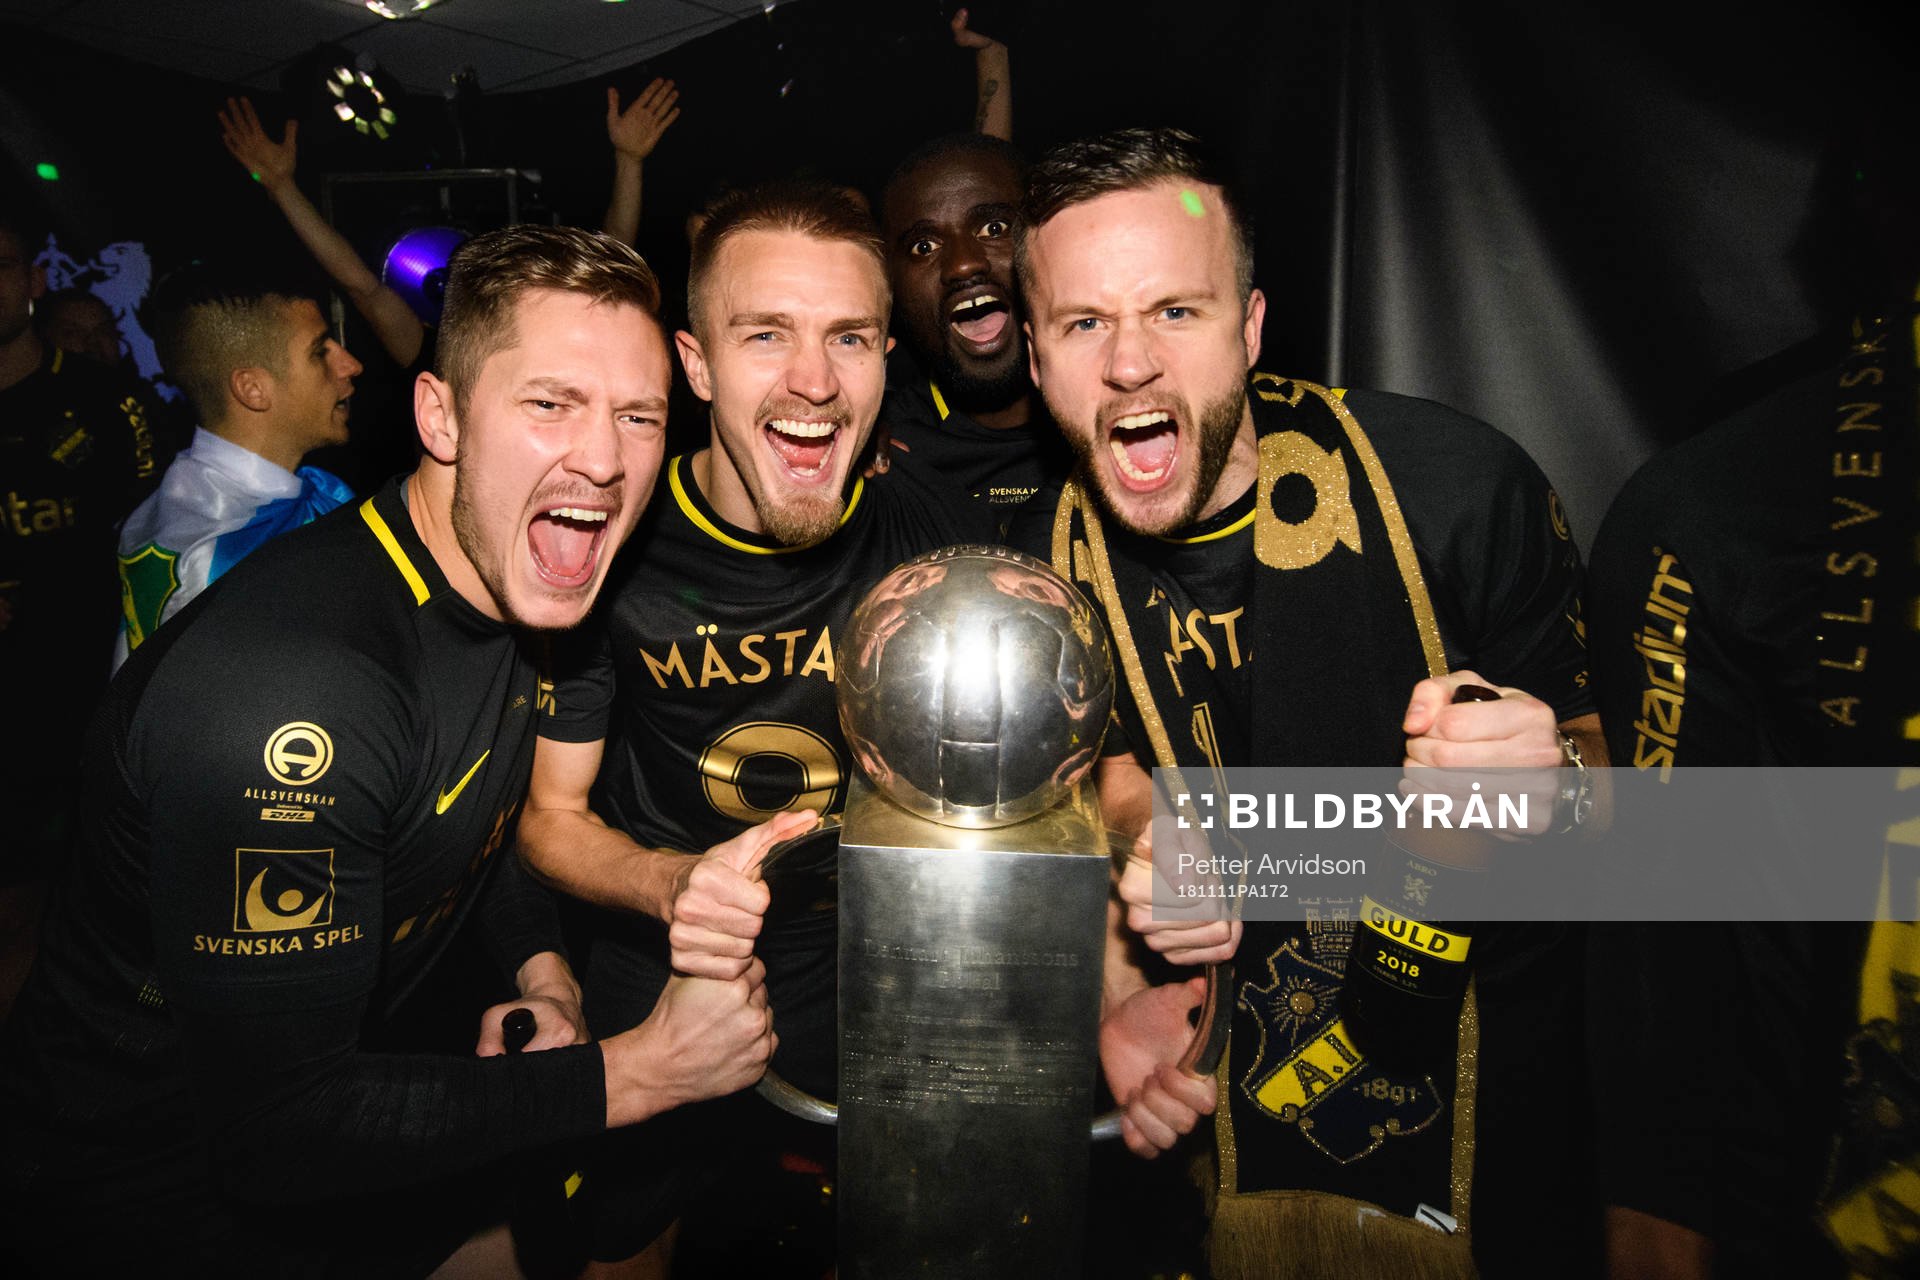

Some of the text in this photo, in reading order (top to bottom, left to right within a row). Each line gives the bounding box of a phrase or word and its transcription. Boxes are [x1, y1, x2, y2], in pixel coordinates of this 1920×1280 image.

[989, 487, 1029, 496] SVENSKA
[243, 786, 336, 808] ALLSVENSKAN
[193, 924, 365, 957] SVENSKA SPEL
[1370, 906, 1450, 953] GULD
[1376, 950, 1420, 977] 2018
